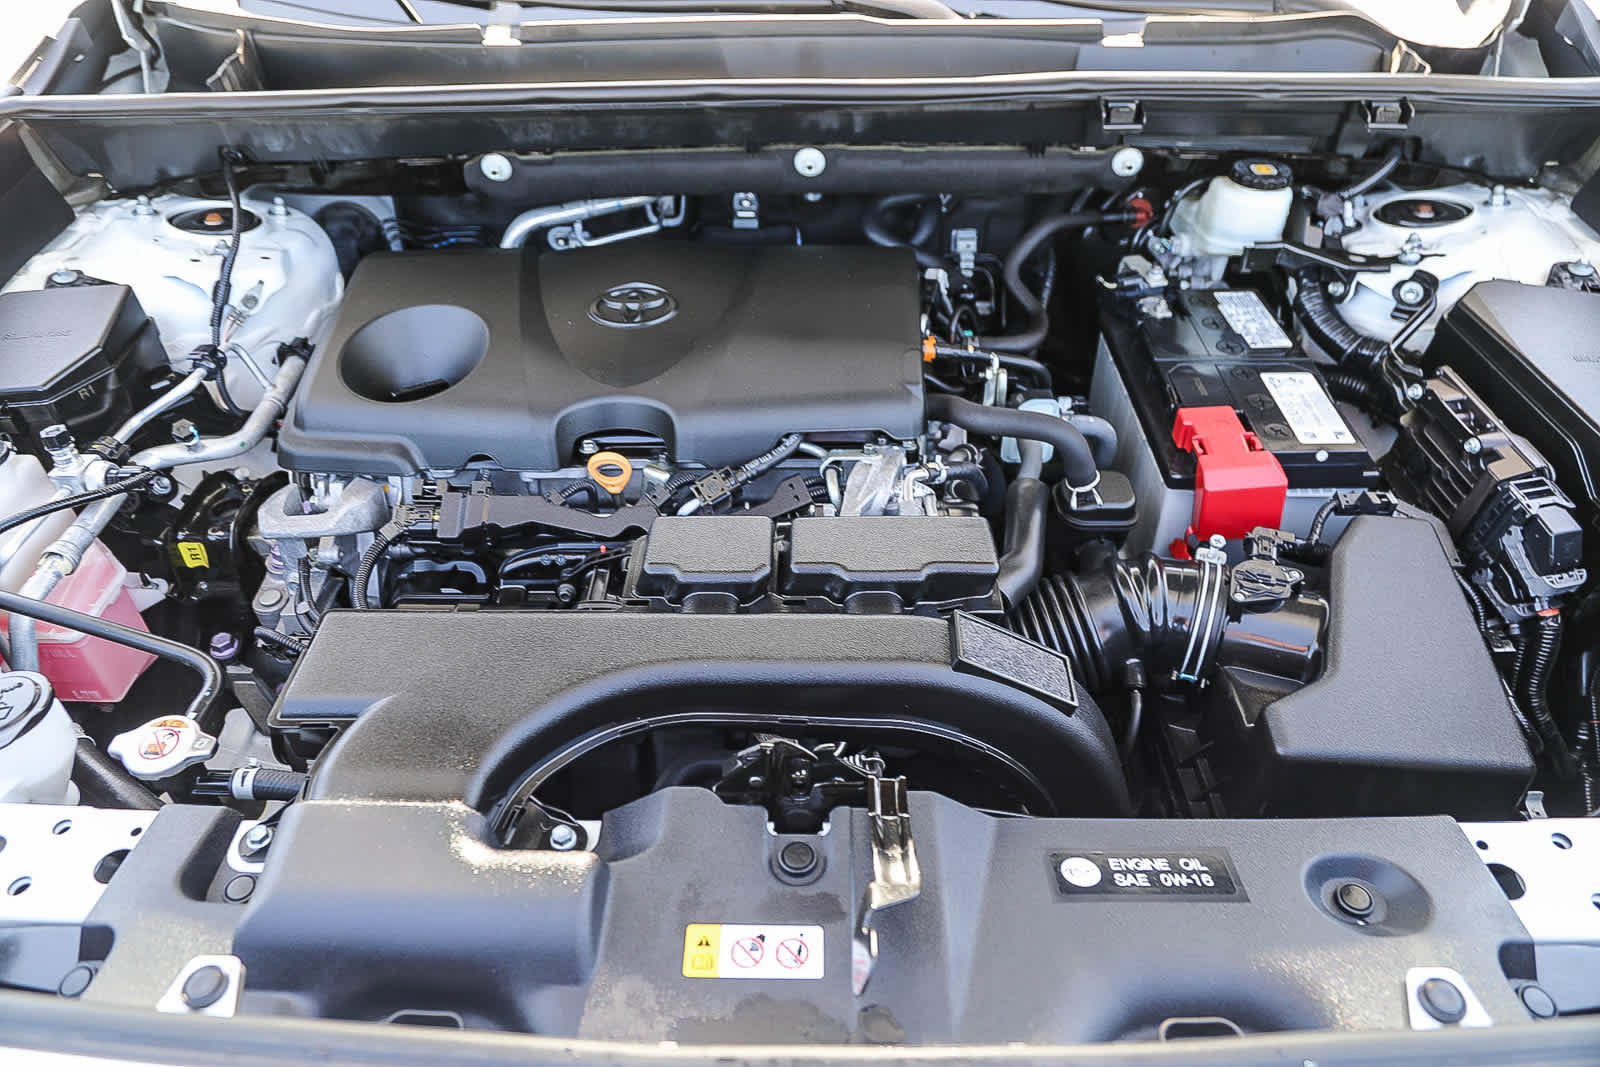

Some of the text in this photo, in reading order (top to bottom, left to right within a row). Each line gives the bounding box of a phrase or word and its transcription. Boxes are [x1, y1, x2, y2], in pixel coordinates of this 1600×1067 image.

[1107, 858, 1172, 872] ENGINE
[1178, 858, 1209, 872] OIL
[1113, 873, 1215, 888] SAE 0W-16
